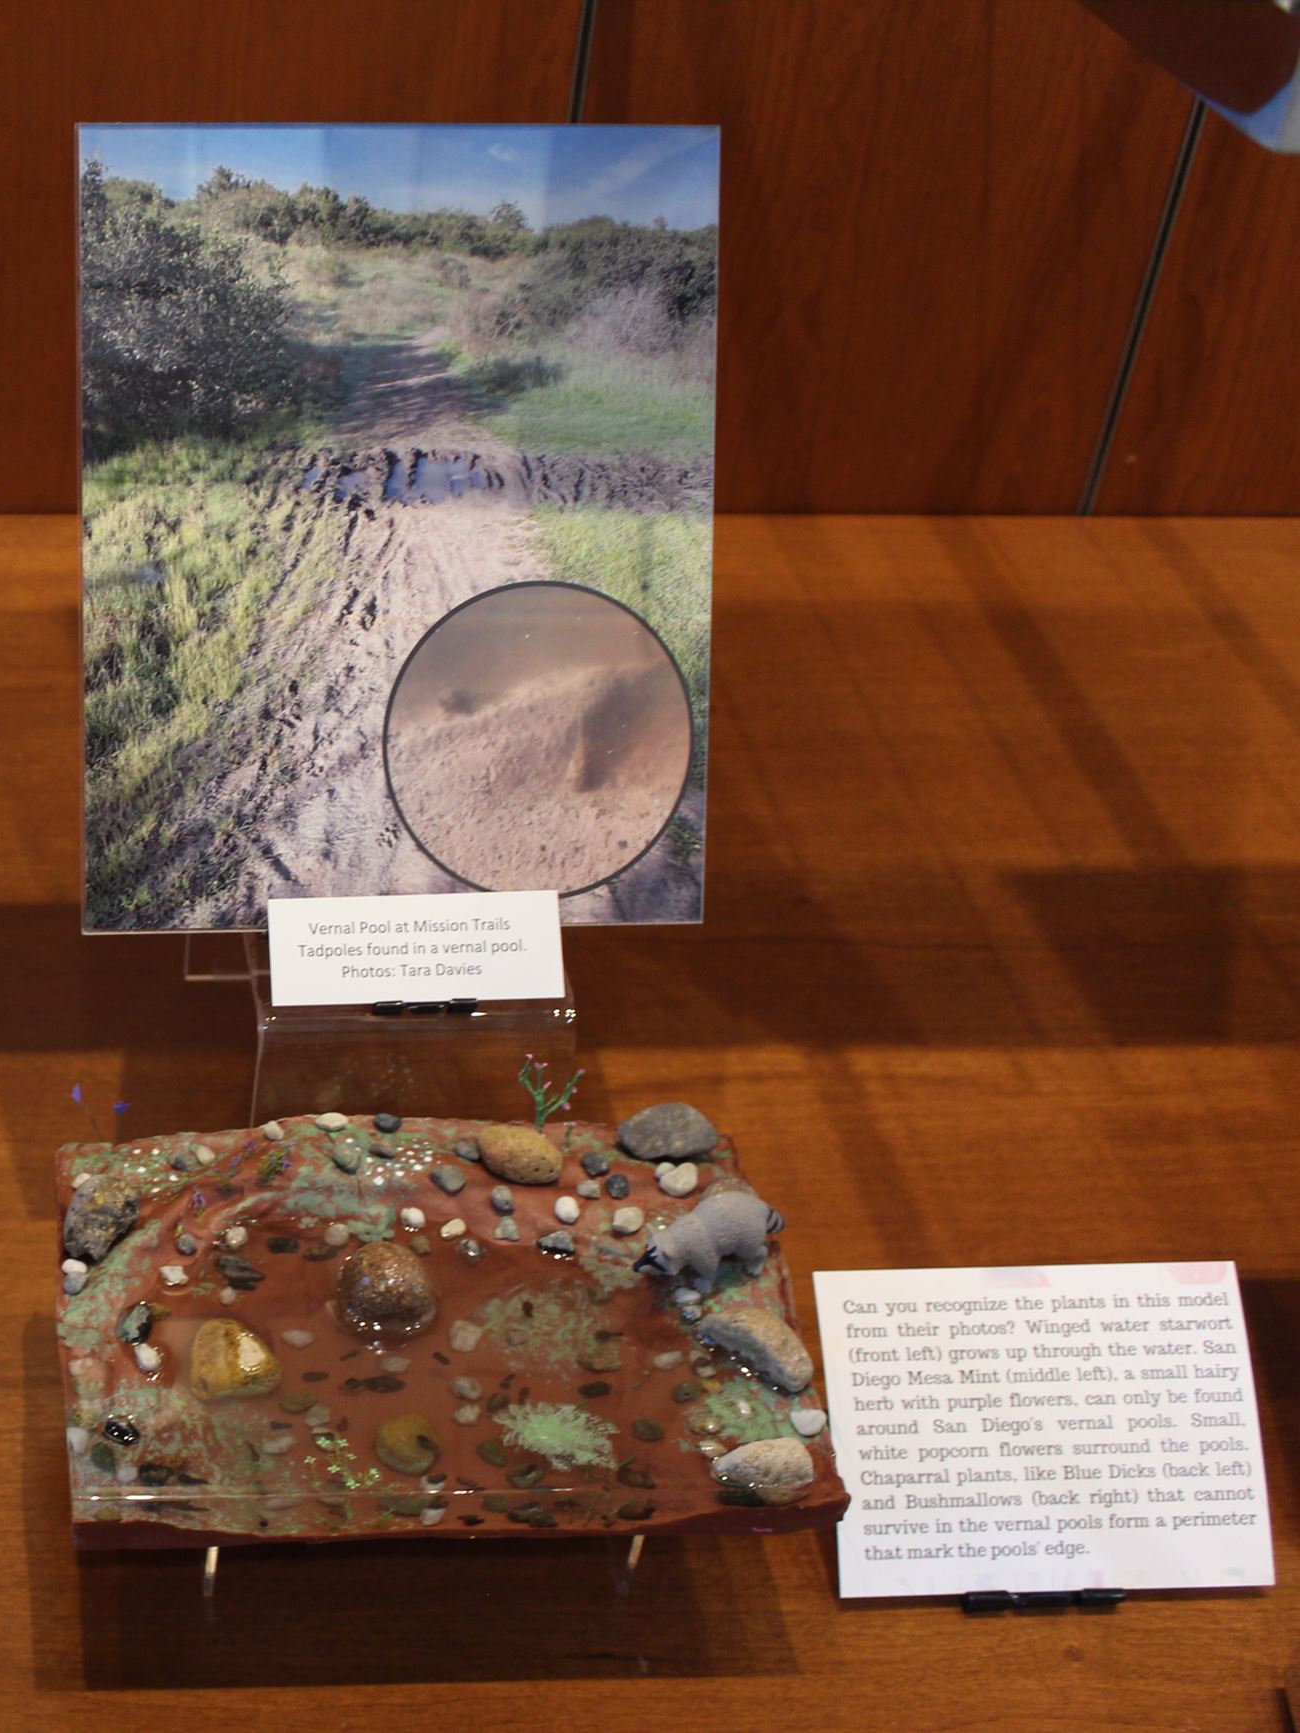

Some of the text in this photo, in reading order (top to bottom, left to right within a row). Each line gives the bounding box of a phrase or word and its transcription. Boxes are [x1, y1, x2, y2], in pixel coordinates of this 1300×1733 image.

[308, 917, 510, 935] Vernal Pool at Mission Trails
[298, 939, 527, 959] Tadpoles found in a vernal pool.
[342, 962, 482, 979] Photos: Tara Davies
[843, 1292, 1229, 1316] Can you recognize the plants in this model
[846, 1317, 1233, 1338] from their photos? Winged water starwort
[849, 1340, 1236, 1364] (front left) grows up through the water. San
[851, 1364, 1239, 1388] Diego Mesa Mint (middle left), a small hairy
[854, 1388, 1243, 1411] herb with purple flowers, can only be found
[856, 1413, 1246, 1435] around San Diego's vernal pools. Small,
[859, 1437, 1249, 1461] white popcorn flowers surround the pools.
[860, 1461, 1251, 1488] Chaparral plants, like Blue Dicks (back left)
[862, 1487, 1255, 1510] and Bushmallows (back right) that cannot
[864, 1512, 1257, 1535] survive in the vernal pools form a perimeter
[864, 1541, 1090, 1560] that mark the pools' edge.
